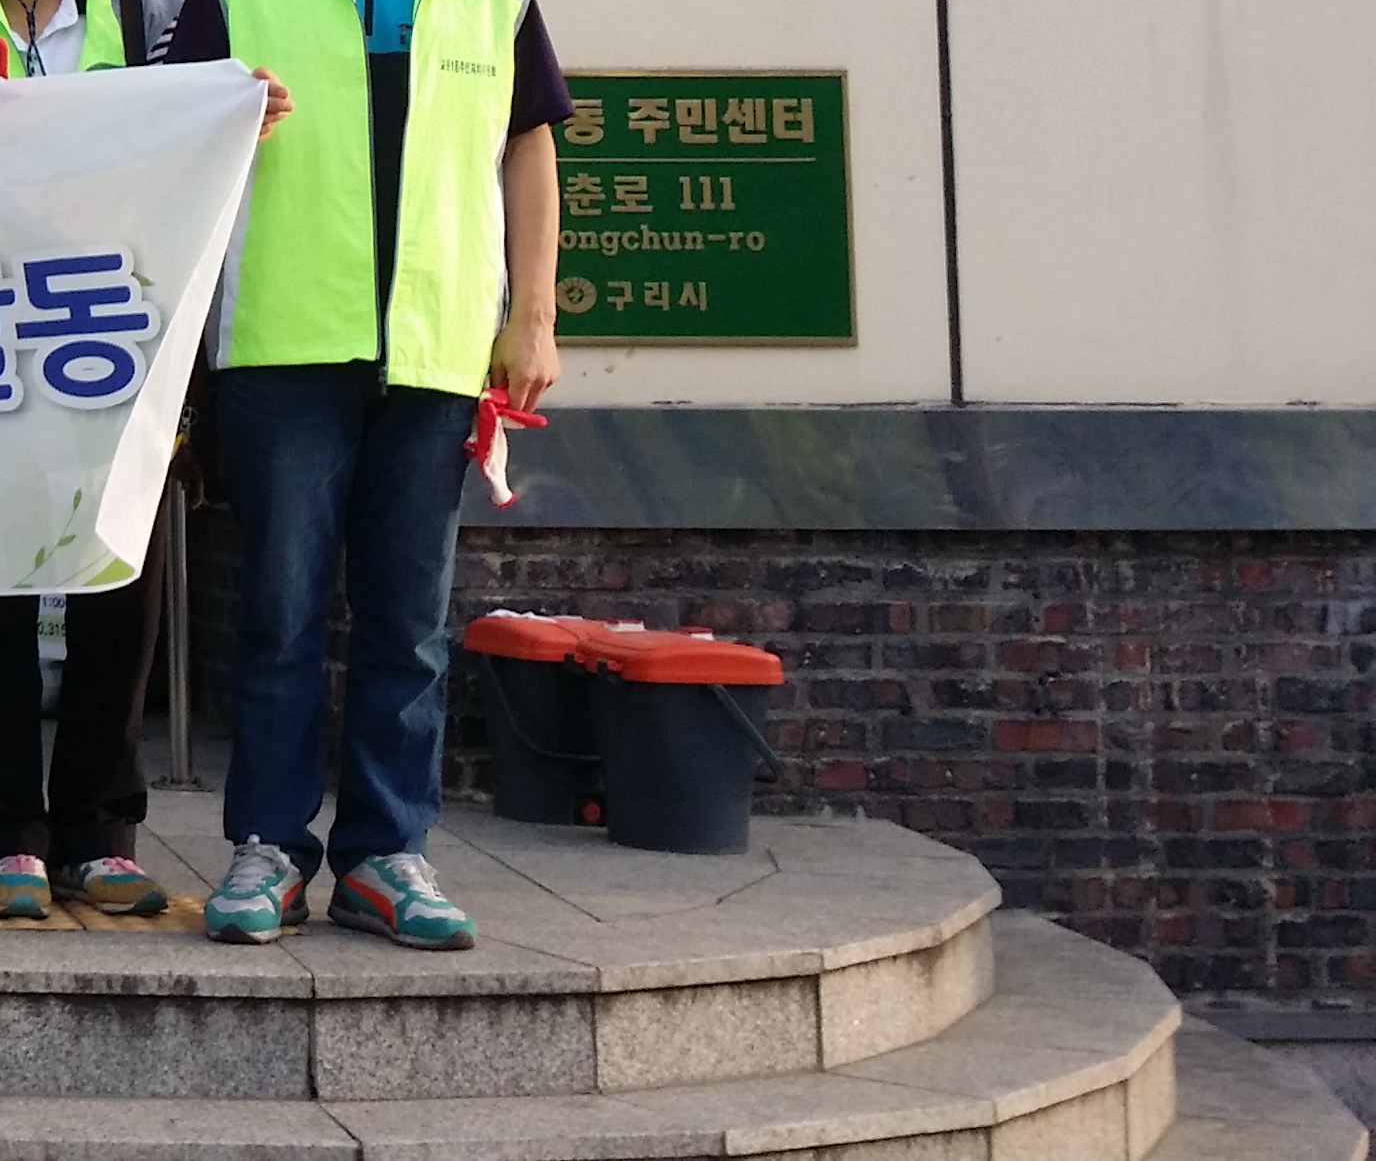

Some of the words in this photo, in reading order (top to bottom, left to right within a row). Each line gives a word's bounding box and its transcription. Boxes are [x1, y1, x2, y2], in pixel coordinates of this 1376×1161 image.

[563, 98, 605, 145] 동
[627, 97, 815, 145] 주민센터
[563, 173, 653, 216] 춘로
[679, 175, 736, 211] 111
[559, 225, 766, 256] ongchun-ro
[607, 280, 708, 312] 구리시
